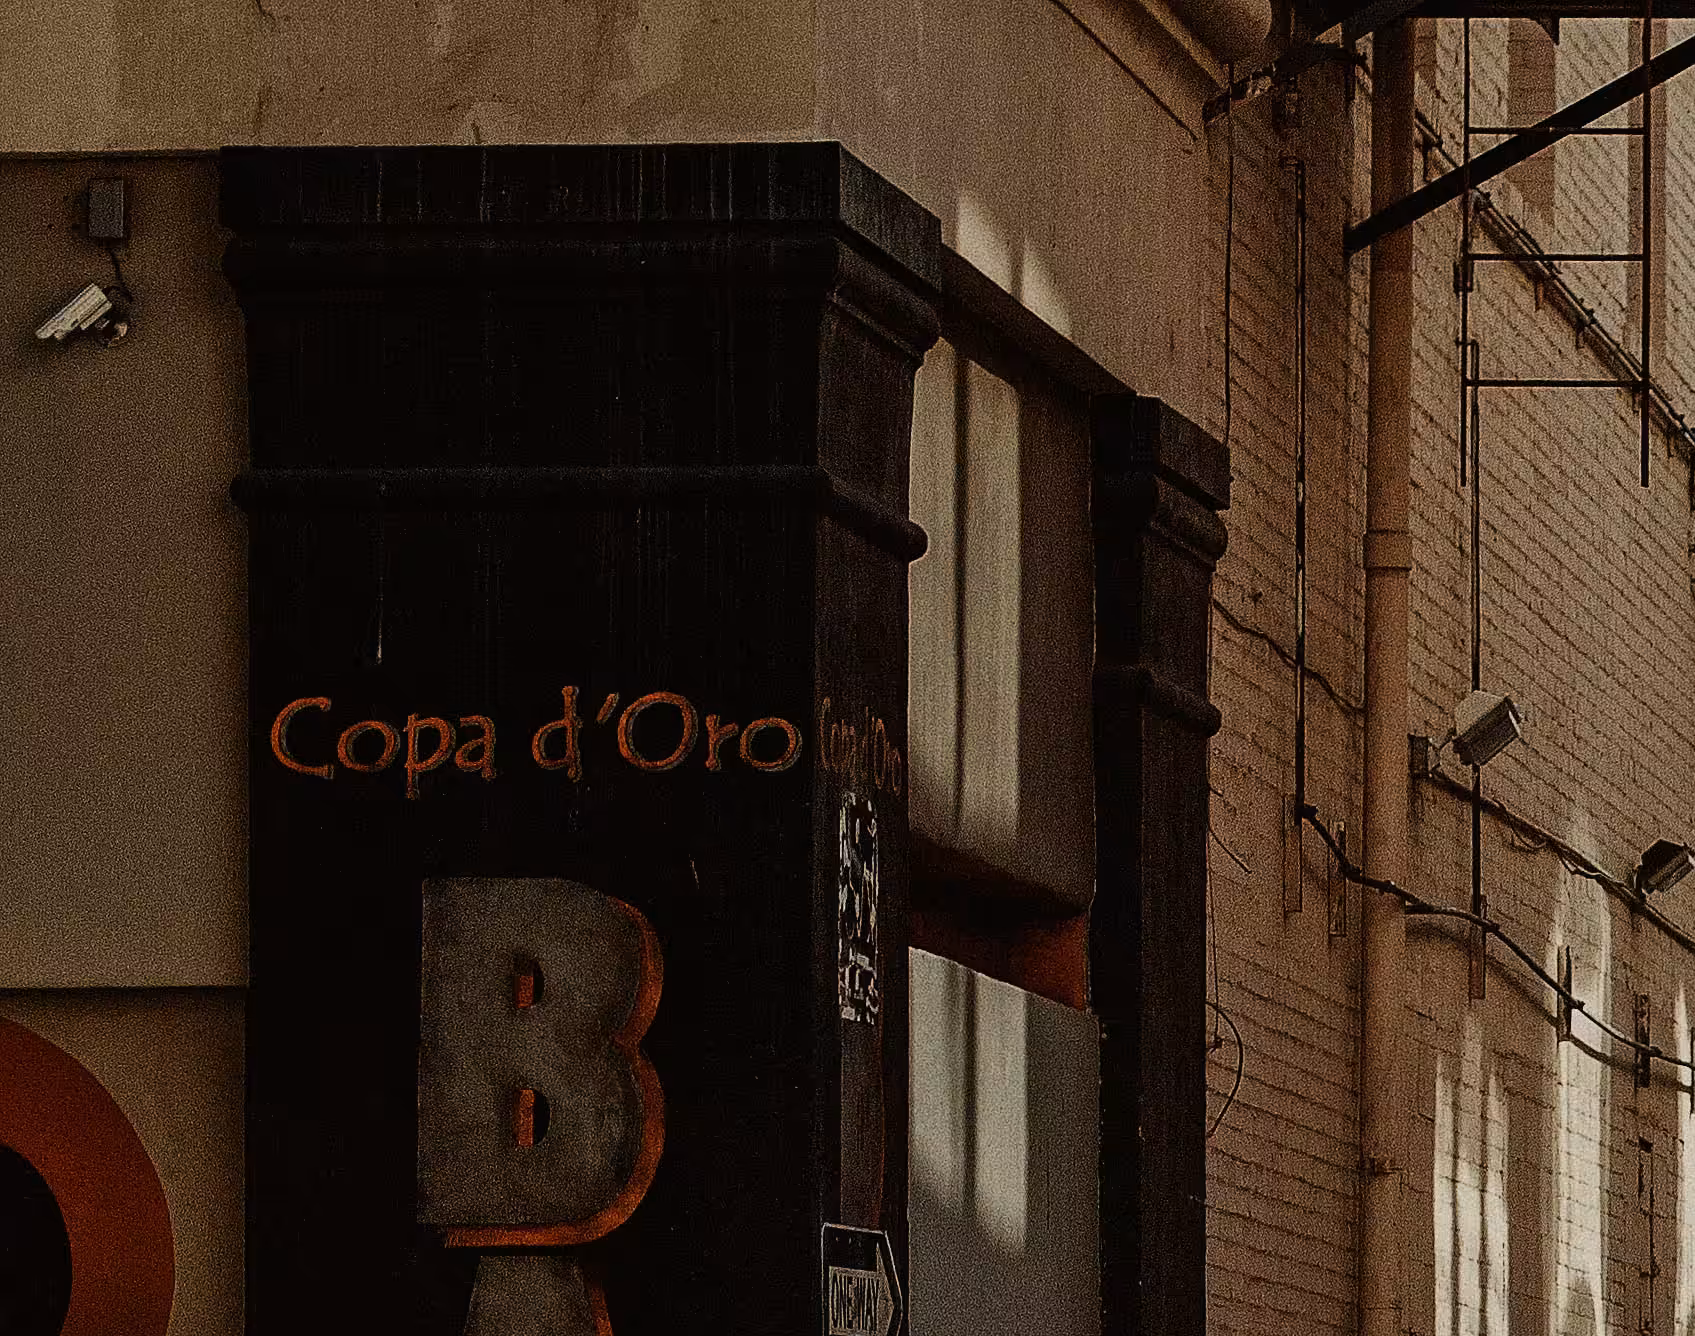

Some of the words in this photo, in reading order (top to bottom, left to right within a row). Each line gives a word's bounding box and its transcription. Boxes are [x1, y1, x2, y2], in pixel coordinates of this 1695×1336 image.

[271, 697, 496, 799] Copa
[532, 686, 802, 782] d'Oro
[831, 1272, 854, 1329] ONE
[856, 1276, 880, 1333] WAY
